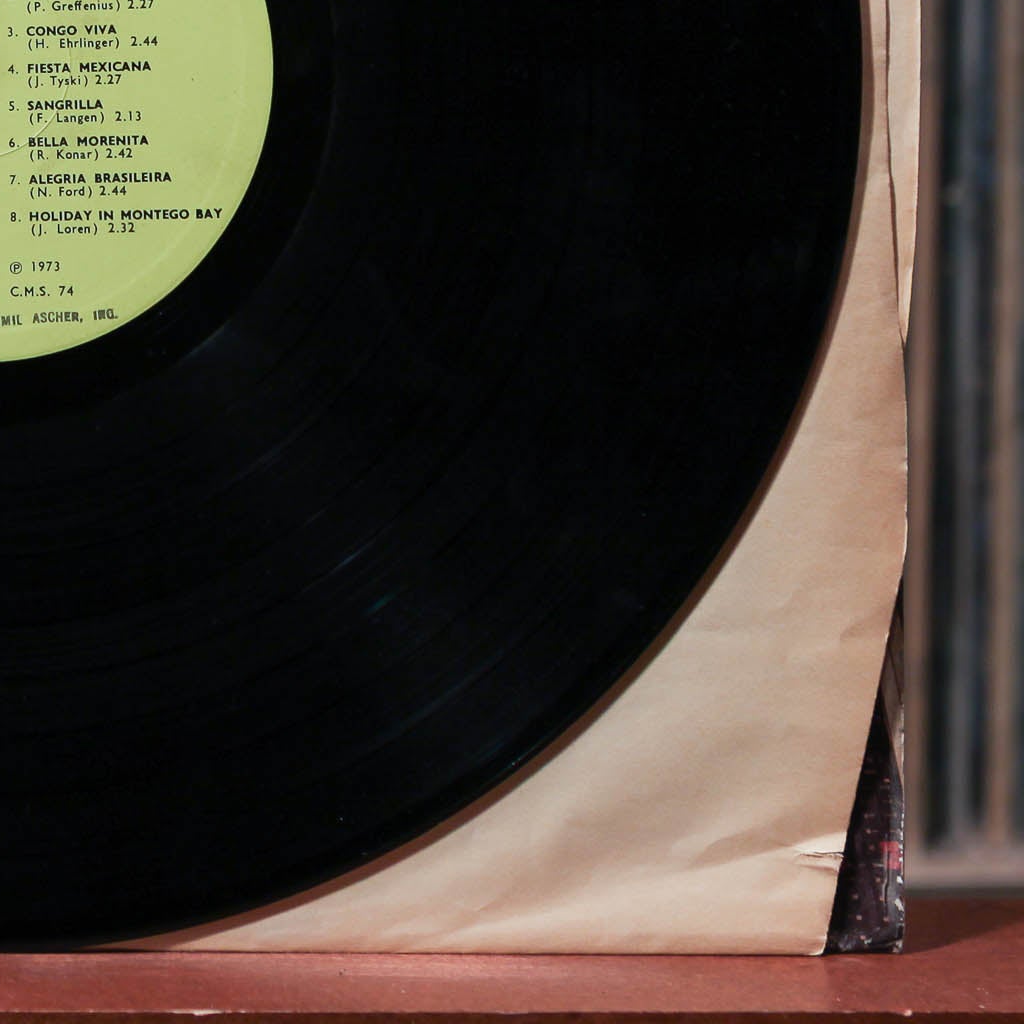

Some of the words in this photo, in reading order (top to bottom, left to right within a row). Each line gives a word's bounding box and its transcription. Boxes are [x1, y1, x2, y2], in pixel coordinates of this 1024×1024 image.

[52, 0, 121, 12] Greffenius)
[7, 26, 18, 37] 3.
[26, 25, 77, 37] CONGO
[84, 25, 117, 35] VIVA
[59, 37, 120, 50] Ehrlinger)
[130, 36, 158, 47] 2.44
[7, 64, 19, 75] 4.
[27, 63, 71, 74] FIESTA
[79, 61, 152, 73] MEXICANA
[51, 75, 89, 87] Tyski)
[95, 74, 122, 85] 2.27
[8, 101, 20, 111] 5.
[27, 99, 103, 111] SANGRILLA
[56, 111, 105, 124] Langen)
[114, 111, 142, 122] 2.13
[8, 137, 20, 148] 6.
[28, 136, 68, 148] BELLA
[77, 135, 149, 146] MORENITA
[56, 148, 99, 161] Konar)
[105, 148, 133, 159] 2.42
[9, 175, 21, 185] 7.
[29, 173, 86, 185] ALEGRIA
[94, 172, 172, 184] BRASILEIRA
[58, 186, 93, 198] Ford)
[99, 185, 127, 196] 2.44
[10, 212, 22, 222] 8.
[29, 210, 92, 222] HOLIDAY
[99, 210, 114, 221] IN
[121, 208, 190, 220] MONTEGO
[195, 208, 223, 219] BAY
[57, 223, 98, 236] Loren)
[107, 222, 136, 234] 2.32
[31, 261, 61, 273] 1973
[10, 286, 51, 298] C.M.S.
[58, 286, 74, 297] 74
[32, 310, 84, 324] ASCHER,
